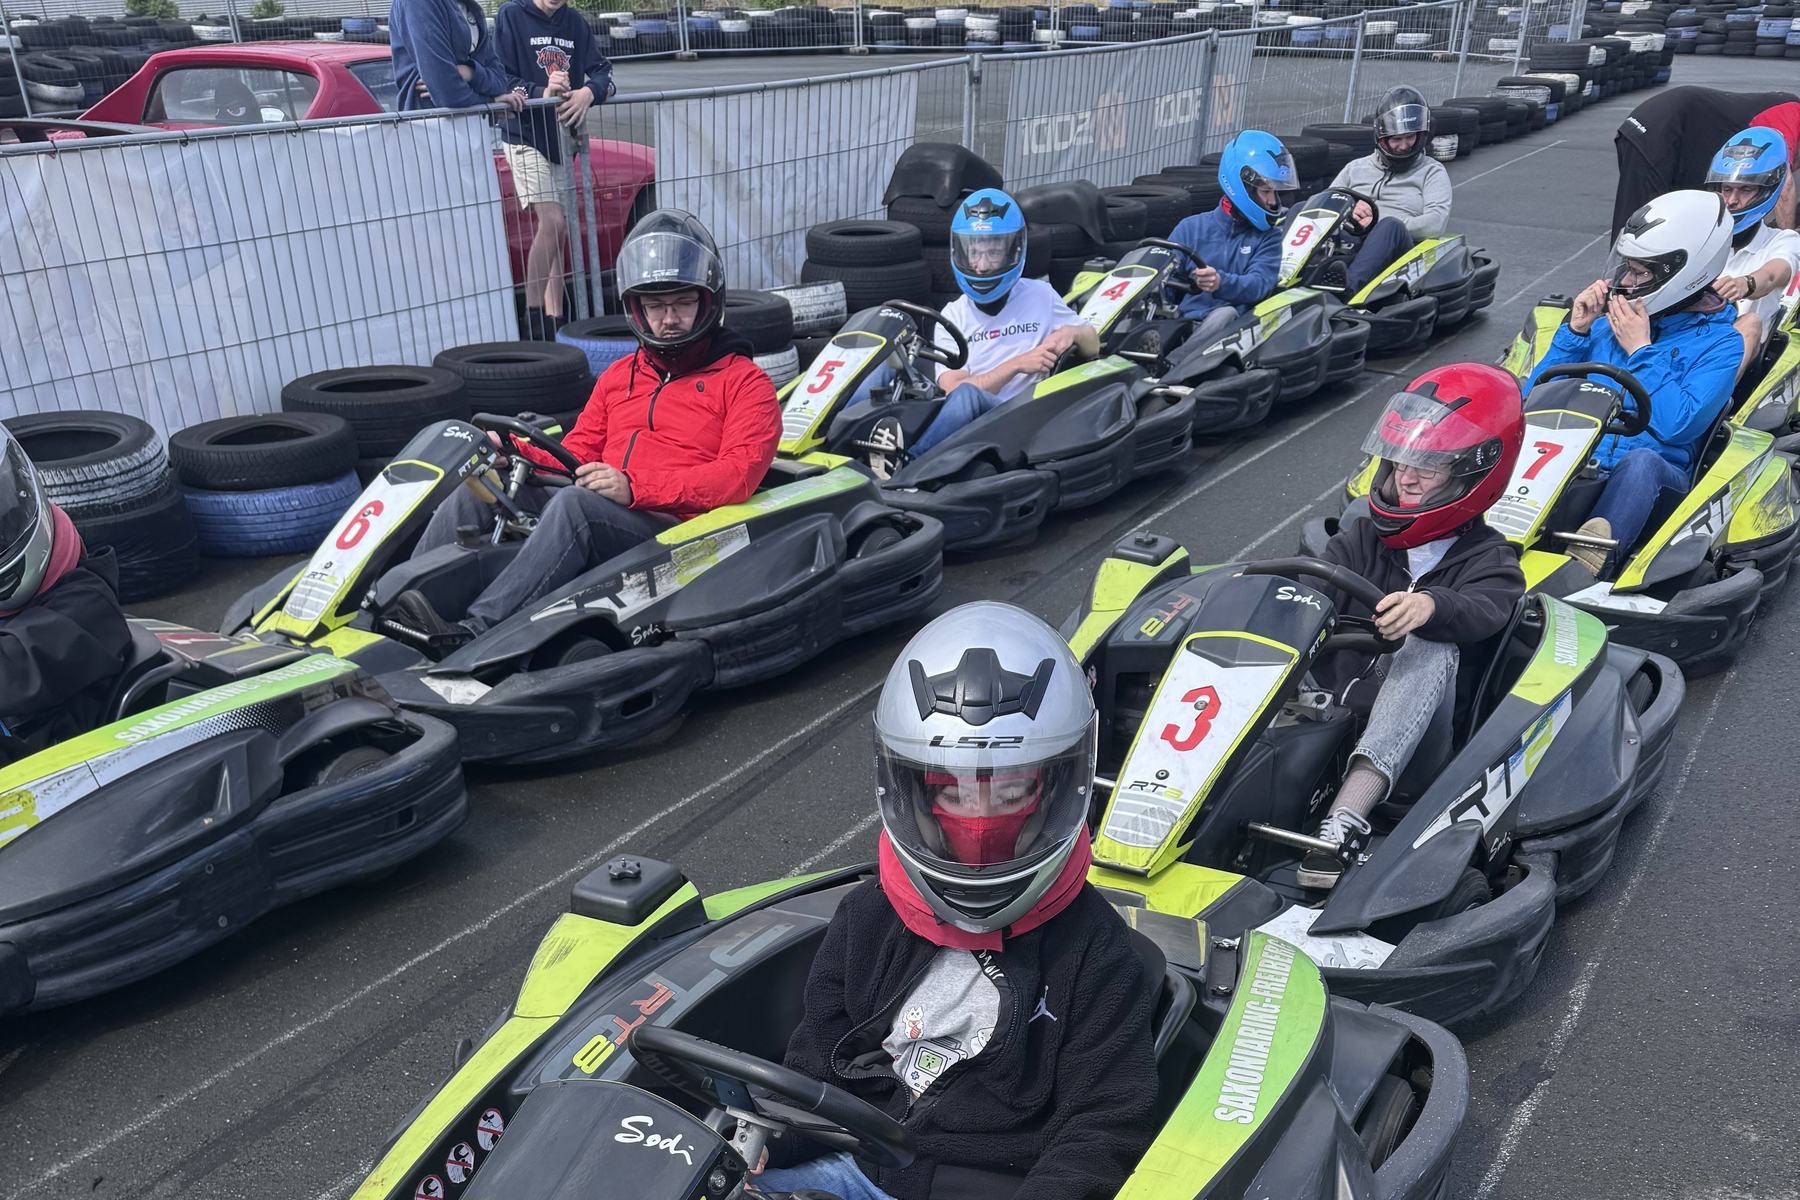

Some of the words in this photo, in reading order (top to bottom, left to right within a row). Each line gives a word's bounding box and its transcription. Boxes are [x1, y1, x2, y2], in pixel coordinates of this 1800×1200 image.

[530, 37, 552, 46] NEW
[554, 39, 576, 49] YORK
[1101, 280, 1132, 301] 4
[1002, 322, 1038, 337] JONES
[806, 360, 847, 395] 5
[1522, 440, 1565, 481] 7
[335, 499, 385, 551] 6
[1275, 586, 1322, 611] Sodi
[1160, 685, 1222, 752] 3
[929, 735, 1025, 750] LS2
[1128, 780, 1185, 800] RT8
[571, 981, 677, 1076] RT8
[1213, 937, 1298, 1125] SAXONIARING-FREIBERG
[614, 1115, 695, 1166] Sodi
